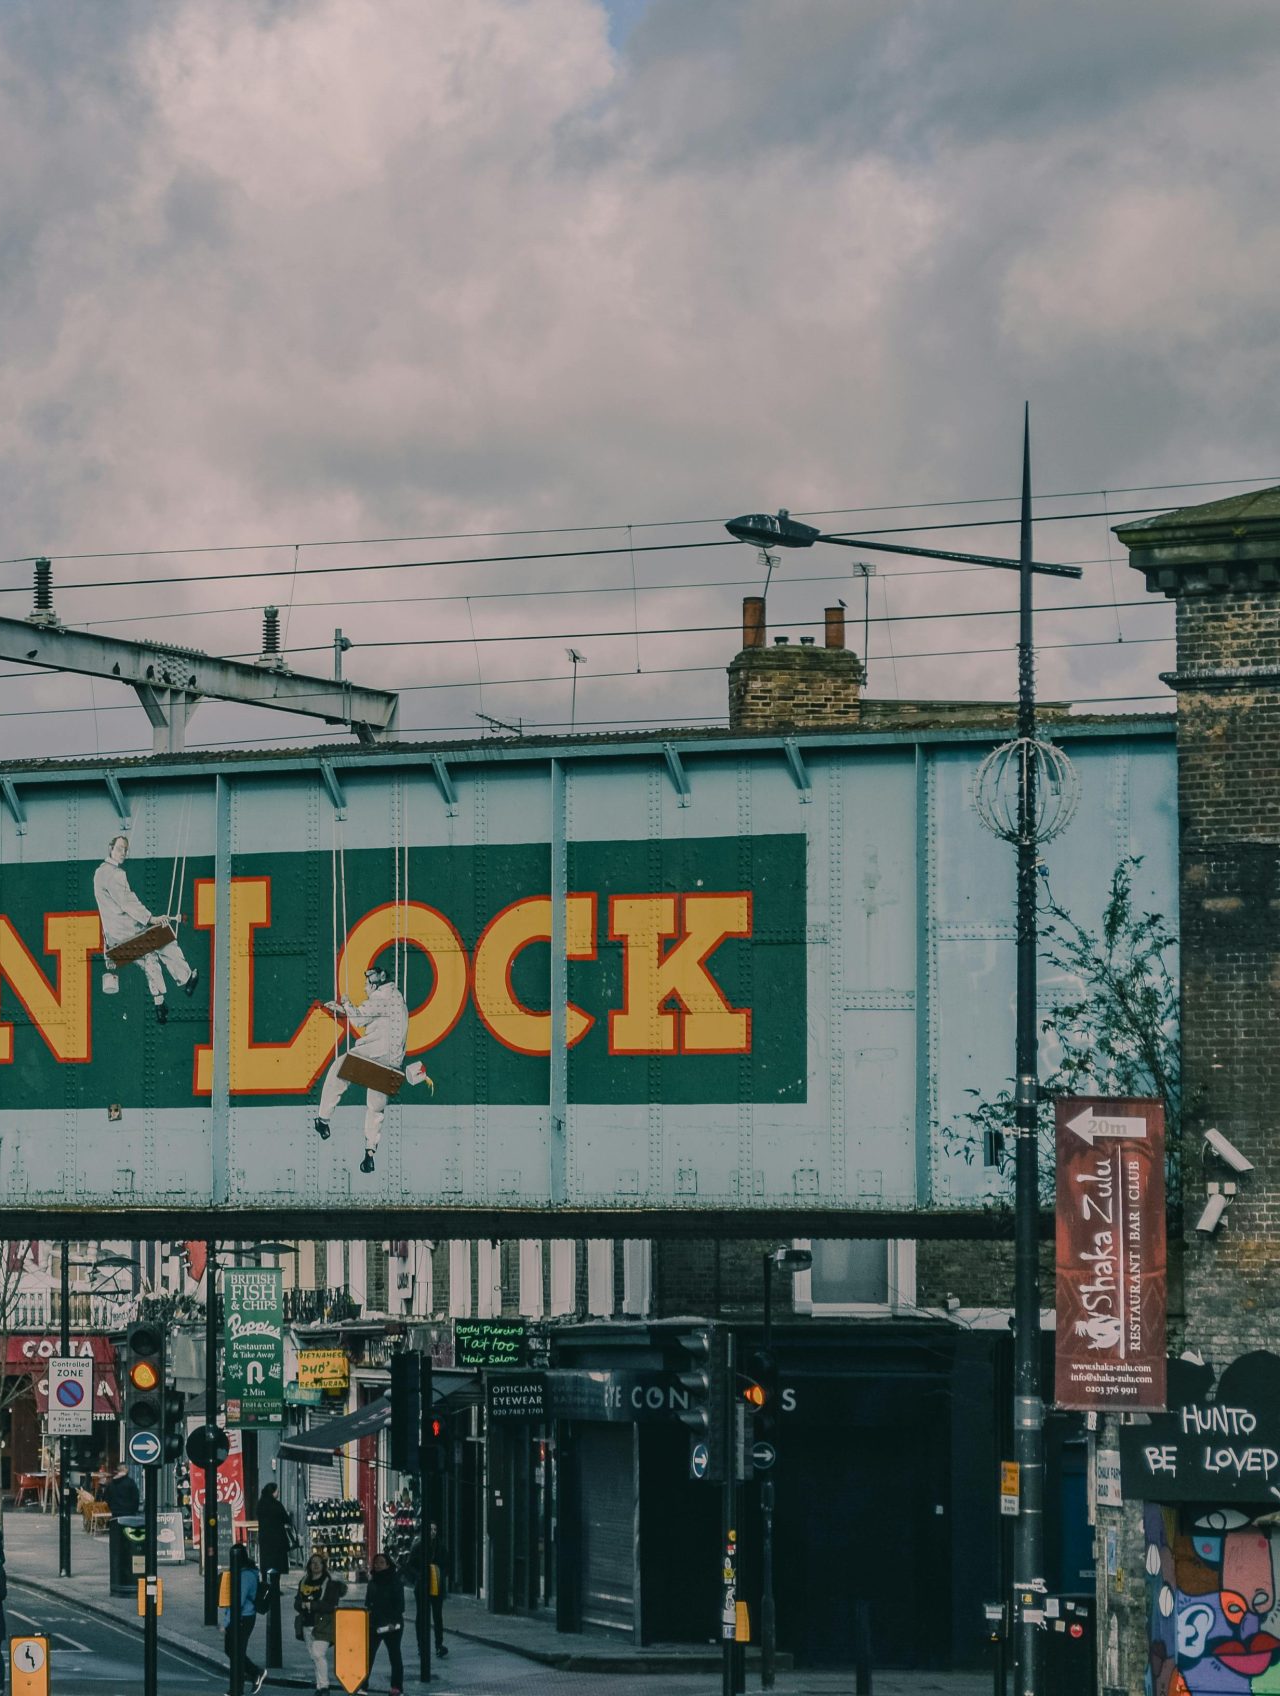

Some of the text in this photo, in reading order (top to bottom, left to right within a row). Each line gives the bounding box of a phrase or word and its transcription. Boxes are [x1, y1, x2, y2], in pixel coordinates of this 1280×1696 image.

[193, 876, 752, 1095] LOCK
[1087, 1119, 1128, 1135] 20m
[1076, 1158, 1118, 1311] Shaka Zulu
[1128, 1160, 1141, 1351] RESTAURANT BAR CLUB
[231, 1274, 276, 1285] BRITISH
[231, 1285, 275, 1301] FISH
[231, 1301, 277, 1311] & CHIPS
[227, 1313, 281, 1338] Poppies
[456, 1325, 524, 1336] Body Piercing
[233, 1342, 275, 1351] Restaurant
[239, 1351, 256, 1359] Take
[256, 1351, 276, 1360] Away
[462, 1354, 519, 1364] Hair Salon
[56, 1369, 84, 1378] ZONE
[1072, 1363, 1152, 1373] www.shaka-zulu.com
[1071, 1373, 1153, 1384] info@shaka-zulu.com
[242, 1388, 266, 1396] 2 Min
[492, 1385, 543, 1393] OPTICIANS
[1085, 1385, 1138, 1395] 0203 376 9911
[493, 1397, 543, 1406] EYEWEAR
[604, 1386, 621, 1408] EYE
[1183, 1404, 1257, 1435] HUNTO
[1144, 1446, 1278, 1477] BE LOVED
